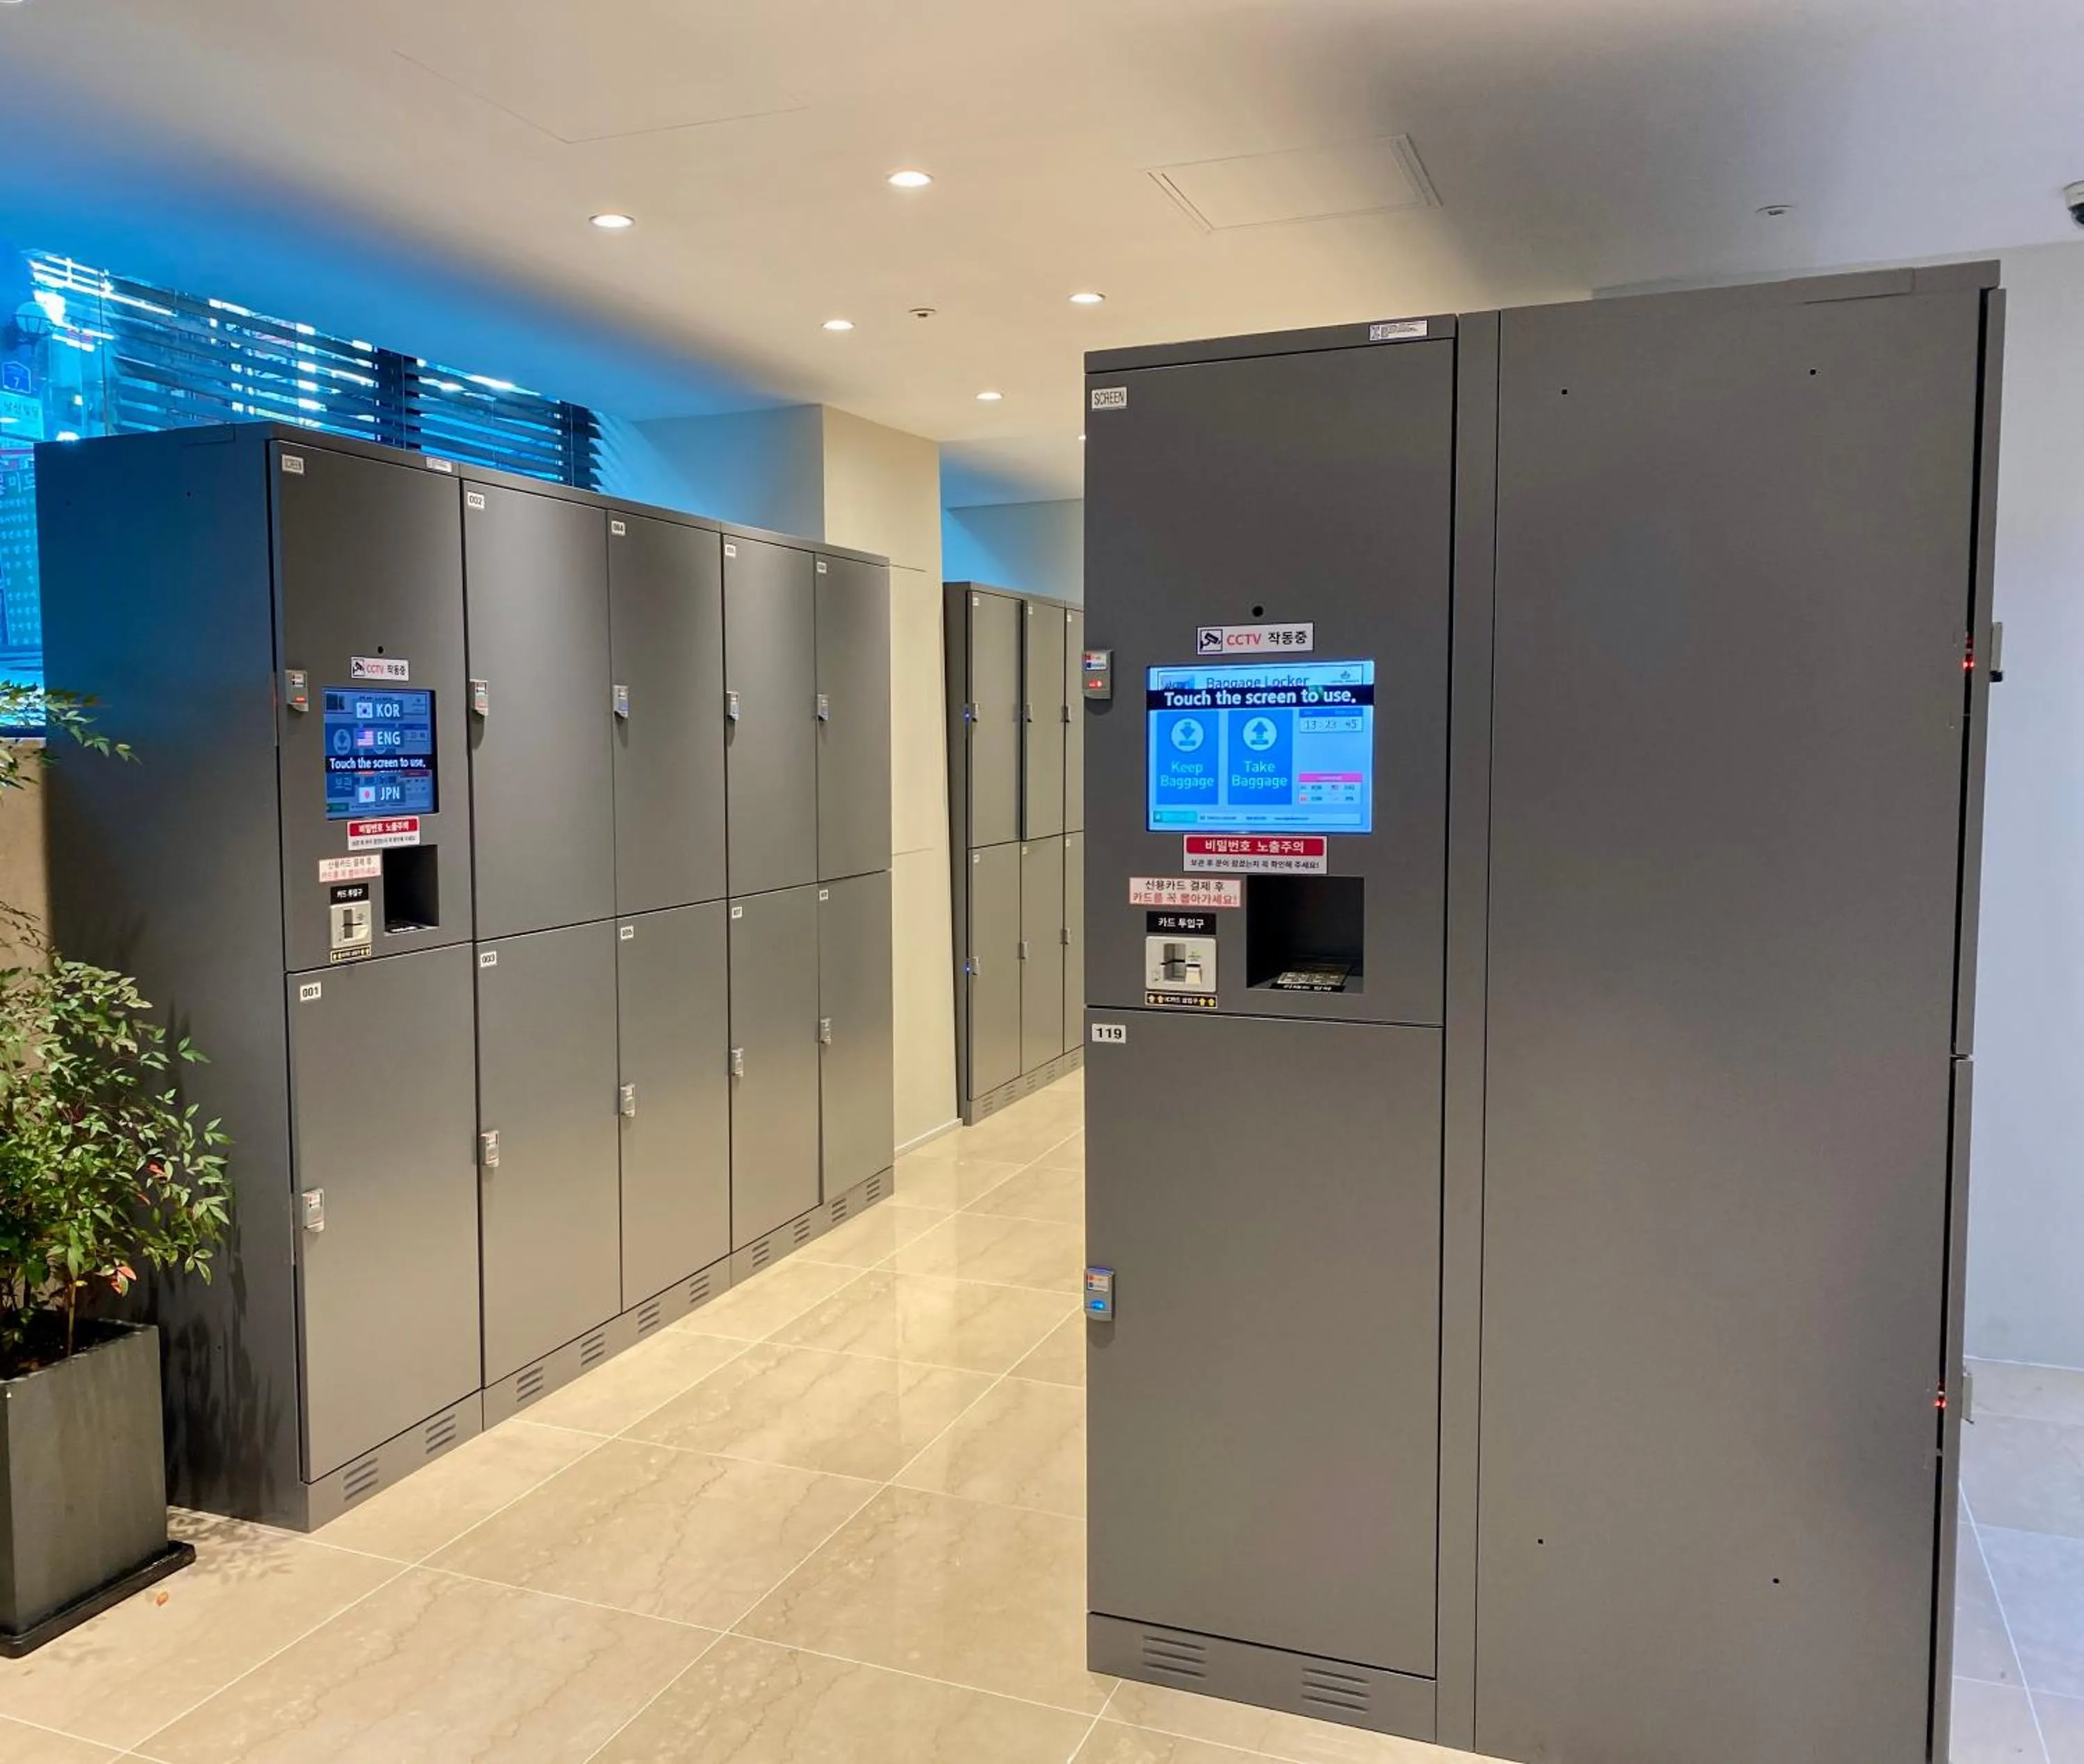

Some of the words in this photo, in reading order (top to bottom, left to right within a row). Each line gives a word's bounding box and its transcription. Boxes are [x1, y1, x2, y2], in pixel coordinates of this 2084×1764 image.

[1093, 390, 1125, 407] SCREEN
[1226, 633, 1262, 646] CCTV
[1268, 631, 1307, 645] 작동중
[366, 665, 384, 674] CCTV
[1164, 690, 1211, 706] Touch
[1216, 689, 1241, 705] the
[1246, 690, 1297, 704] screen
[1301, 688, 1318, 703] to
[1323, 689, 1357, 704] use.
[376, 703, 400, 718] KOR
[377, 731, 401, 746] ENG
[329, 756, 356, 770] Touch
[357, 756, 372, 769] the
[373, 758, 399, 768] screen
[399, 757, 409, 767] to
[1171, 761, 1203, 776] Keep
[1244, 760, 1275, 773] Take
[1159, 774, 1214, 790] Baggage
[1232, 774, 1288, 790] Baggage
[380, 786, 400, 801] JPN
[1205, 839, 1251, 853] 비밀번호
[1257, 840, 1305, 854] 노출주의
[1145, 880, 1186, 891] 신용카드
[1190, 881, 1211, 892] 결제
[1214, 881, 1225, 892] 후
[1133, 891, 1164, 903] 카드를
[1158, 917, 1176, 928] 카드
[1178, 918, 1205, 929] 투입구
[302, 986, 319, 997] 001
[1095, 1027, 1123, 1040] 119
